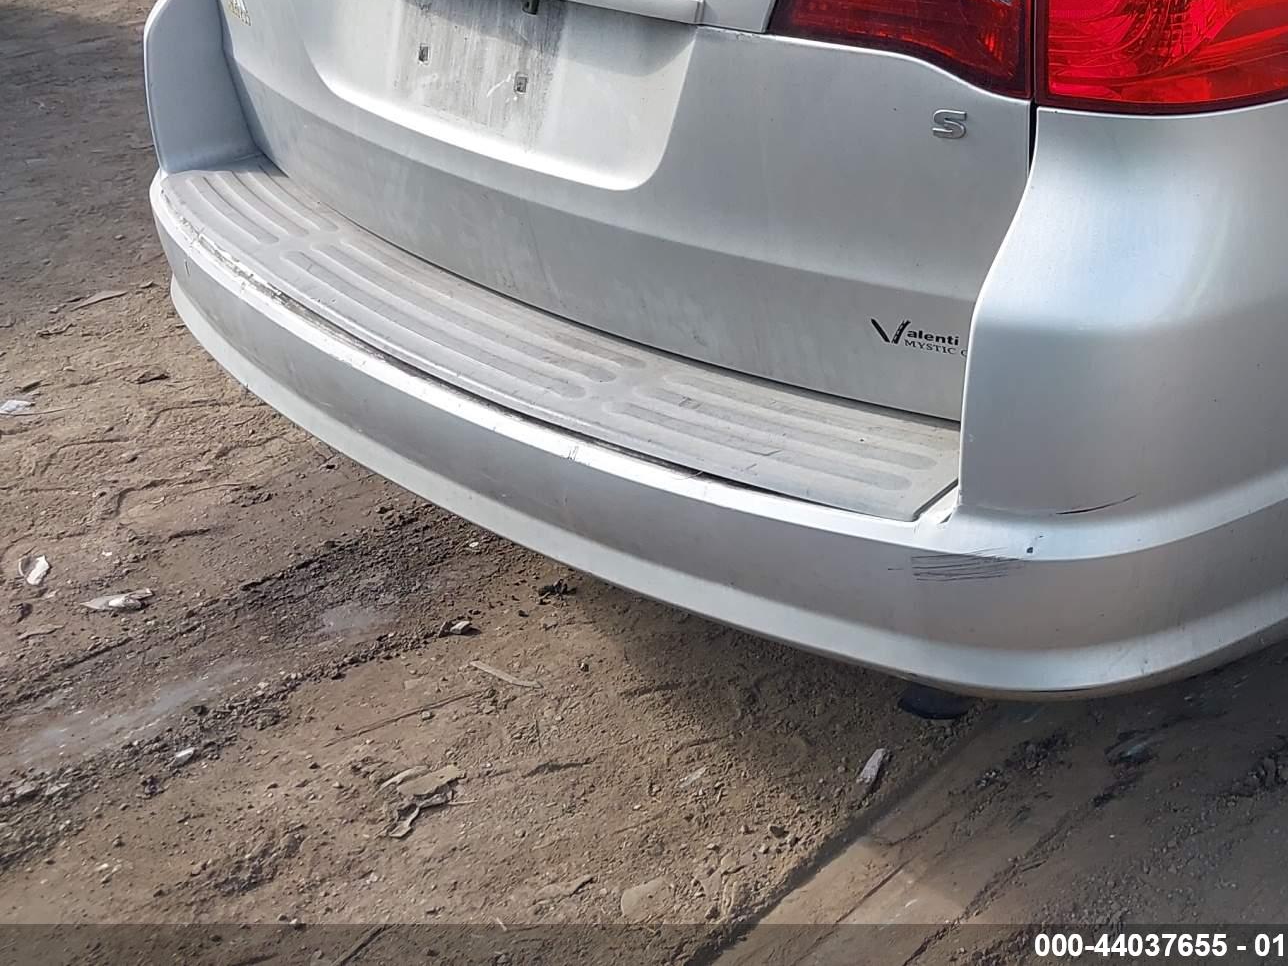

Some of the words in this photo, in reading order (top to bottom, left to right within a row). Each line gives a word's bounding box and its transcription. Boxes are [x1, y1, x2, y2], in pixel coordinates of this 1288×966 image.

[931, 108, 968, 139] S
[870, 318, 960, 346] Valenti
[904, 338, 957, 355] MYSTIC
